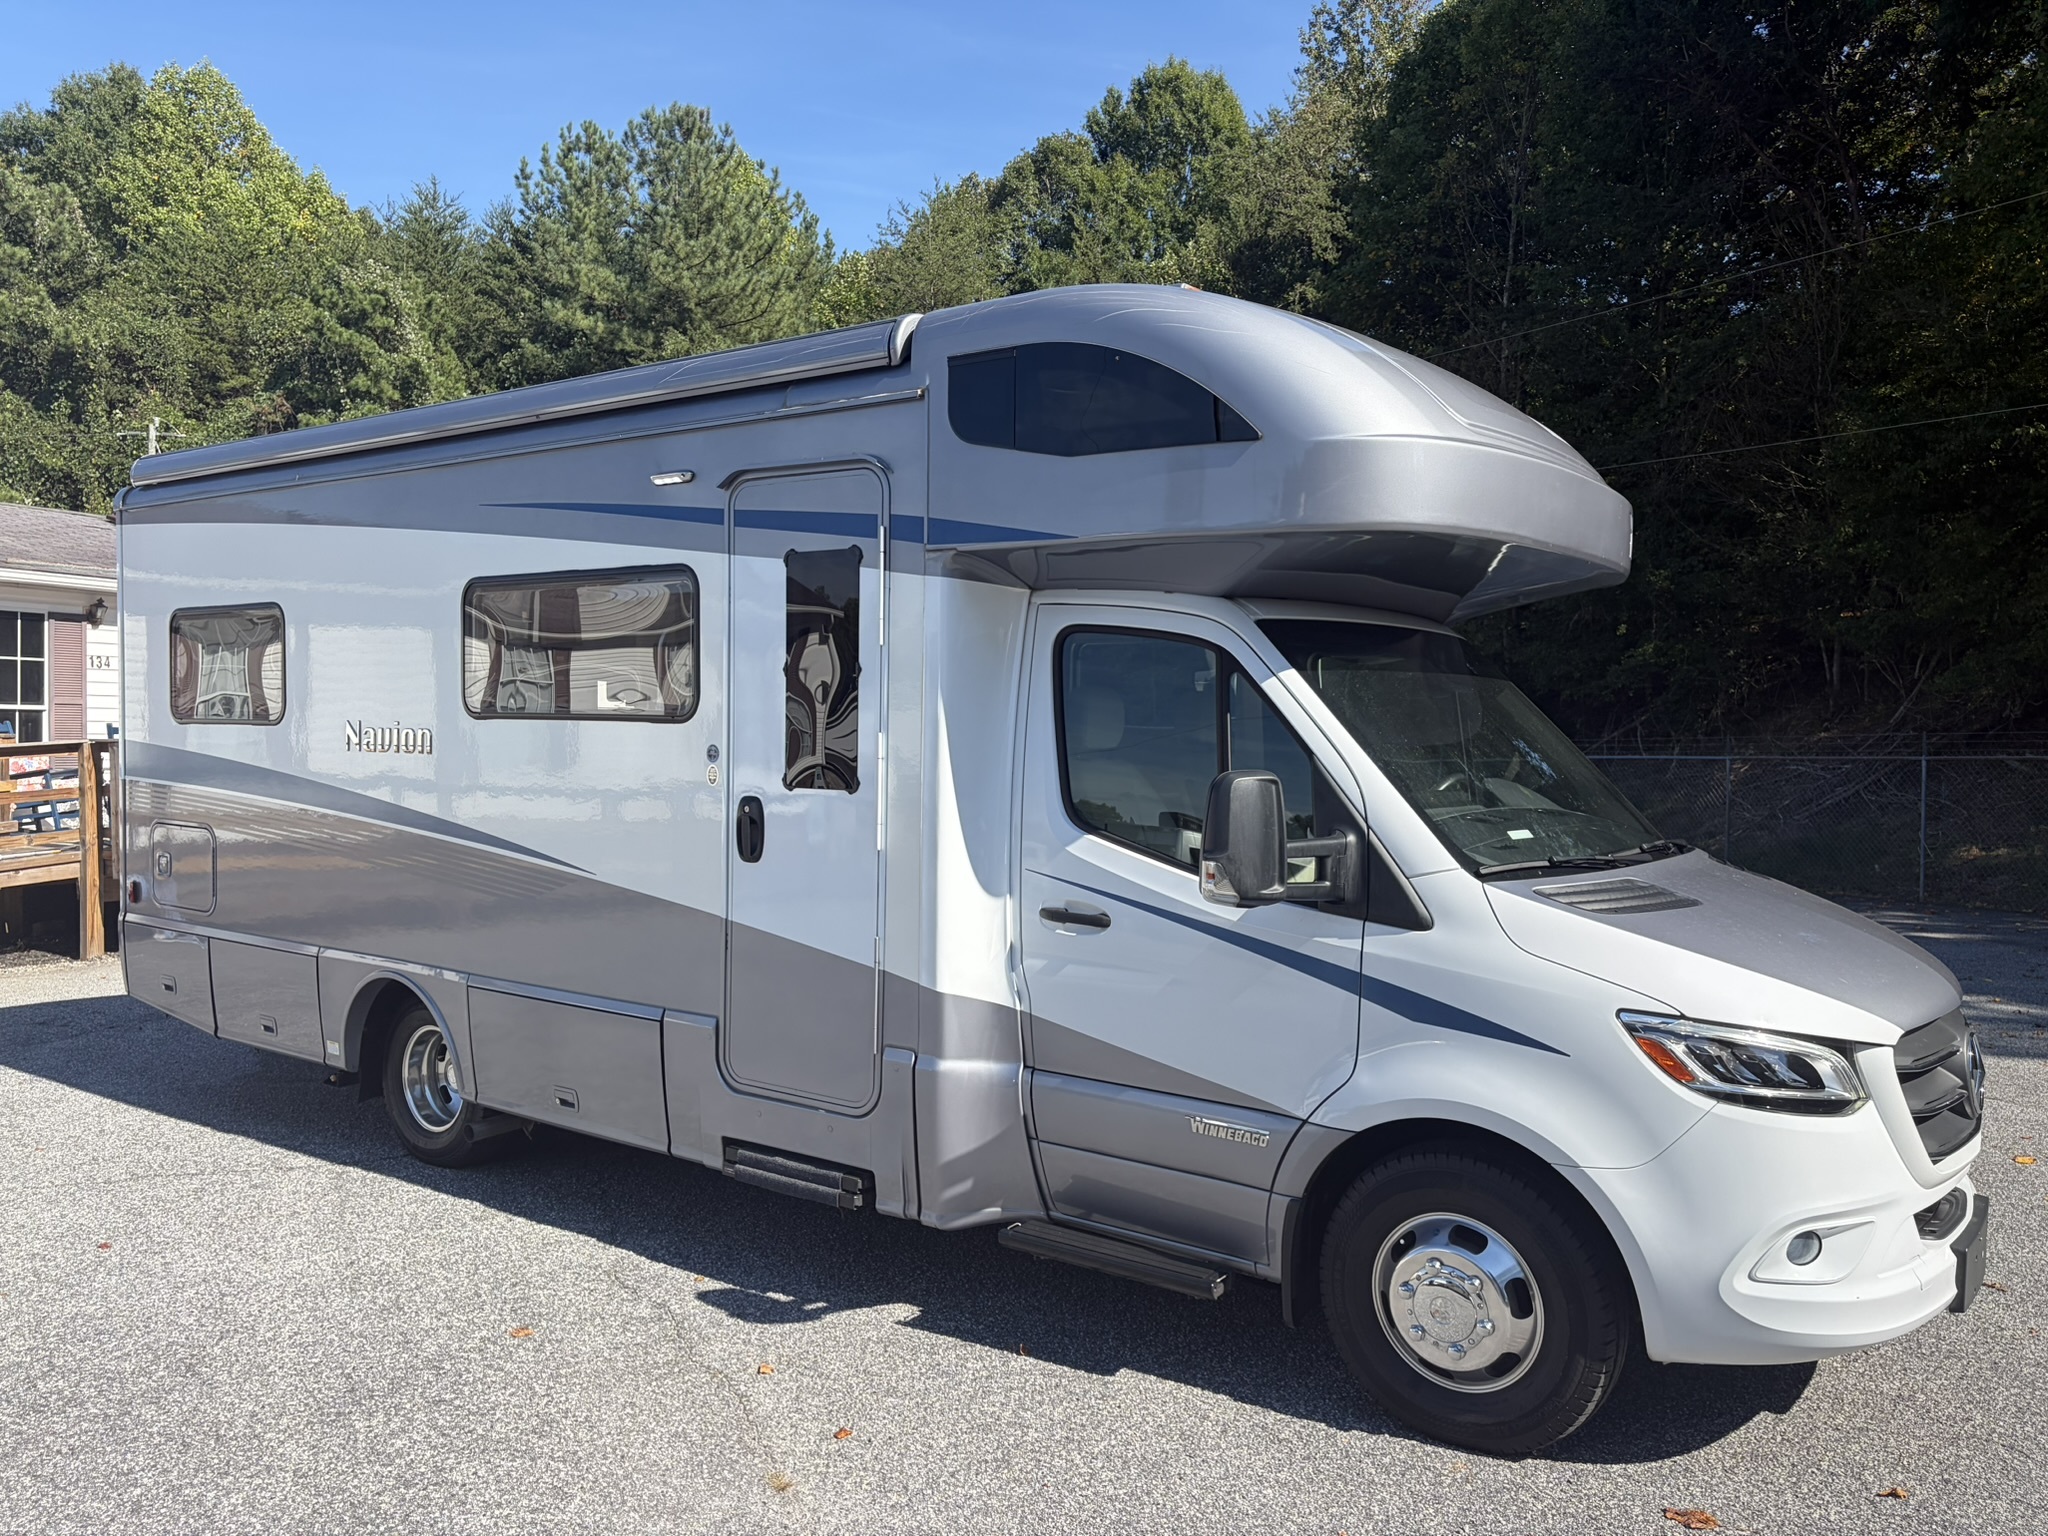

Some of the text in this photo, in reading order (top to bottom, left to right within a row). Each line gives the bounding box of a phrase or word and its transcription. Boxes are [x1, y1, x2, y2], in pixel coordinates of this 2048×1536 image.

[89, 655, 110, 669] 134
[345, 719, 433, 755] Navion
[1185, 1115, 1269, 1148] WINNEBAGO
